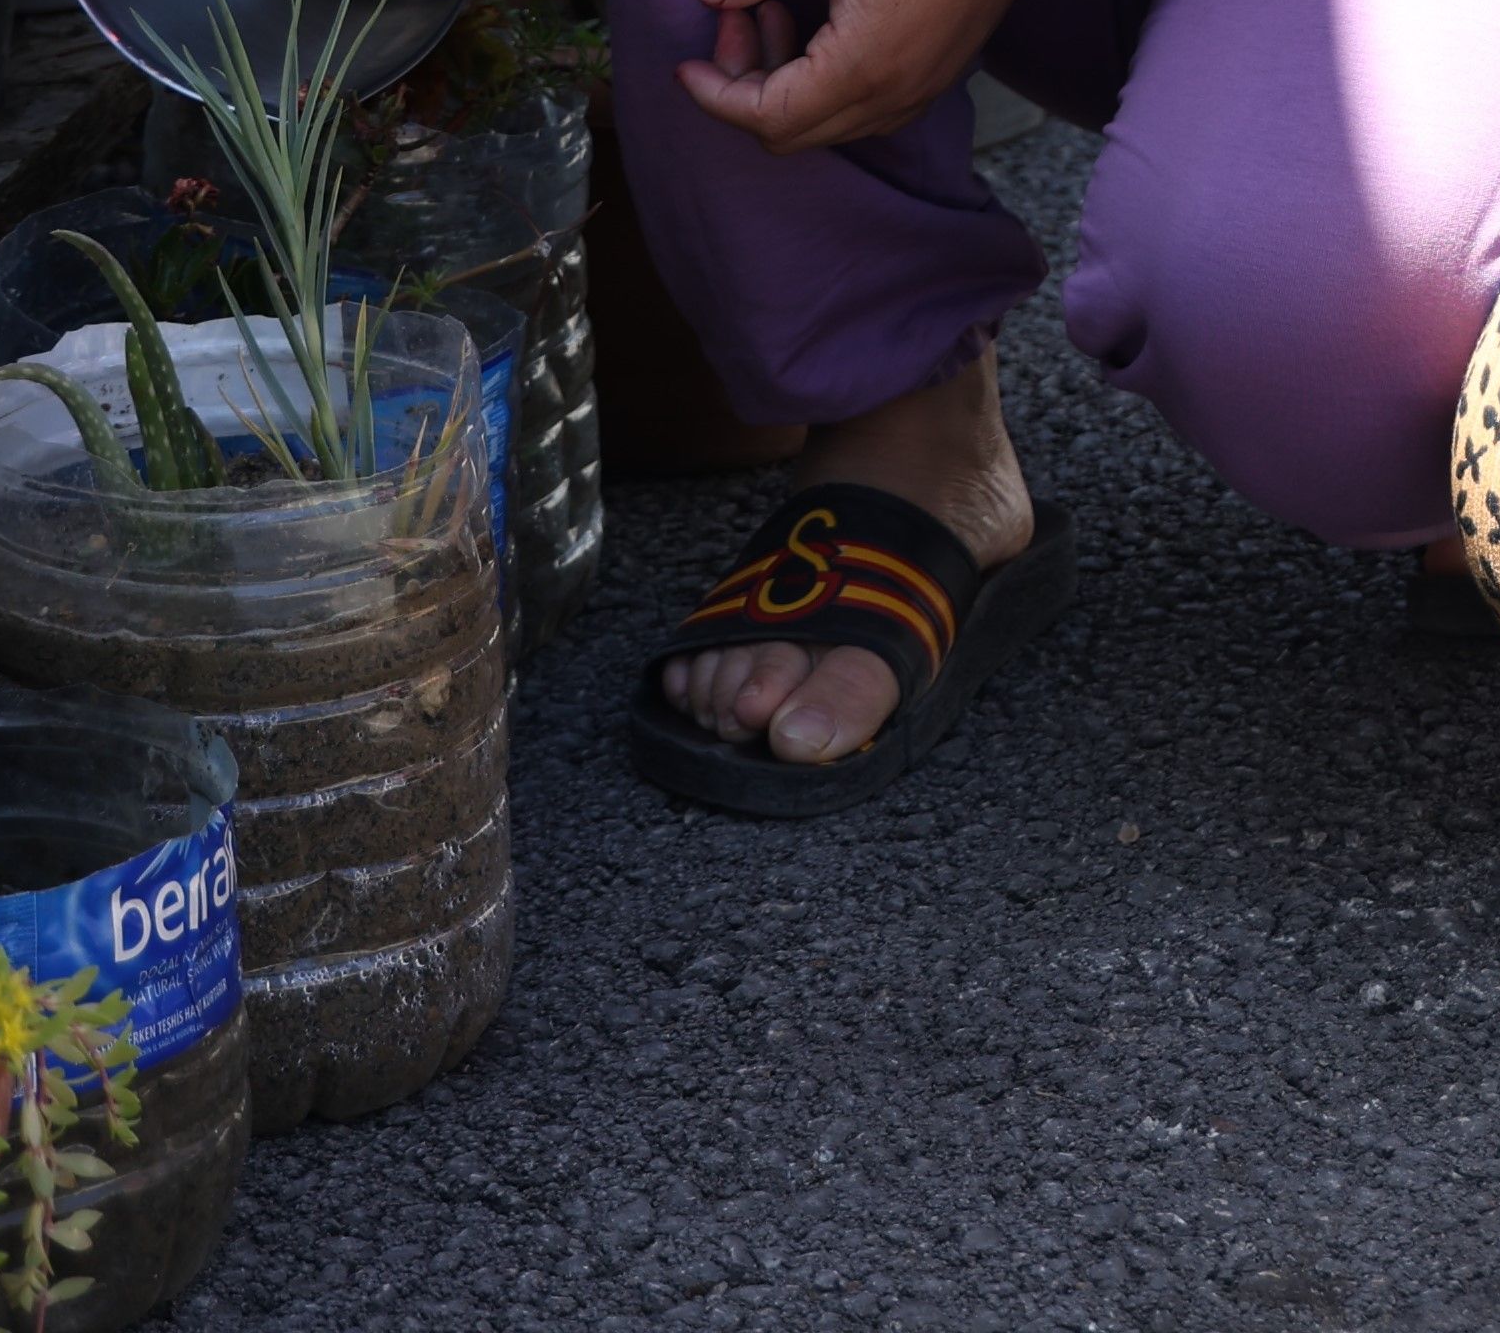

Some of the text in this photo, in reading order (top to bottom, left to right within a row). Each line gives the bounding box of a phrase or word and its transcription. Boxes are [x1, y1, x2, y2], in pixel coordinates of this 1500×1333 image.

[139, 955, 180, 985] DOĞAL
[127, 973, 183, 1006] NATURAL
[128, 1024, 156, 1045] ERKEN
[157, 1008, 184, 1034] TEŞHİS
